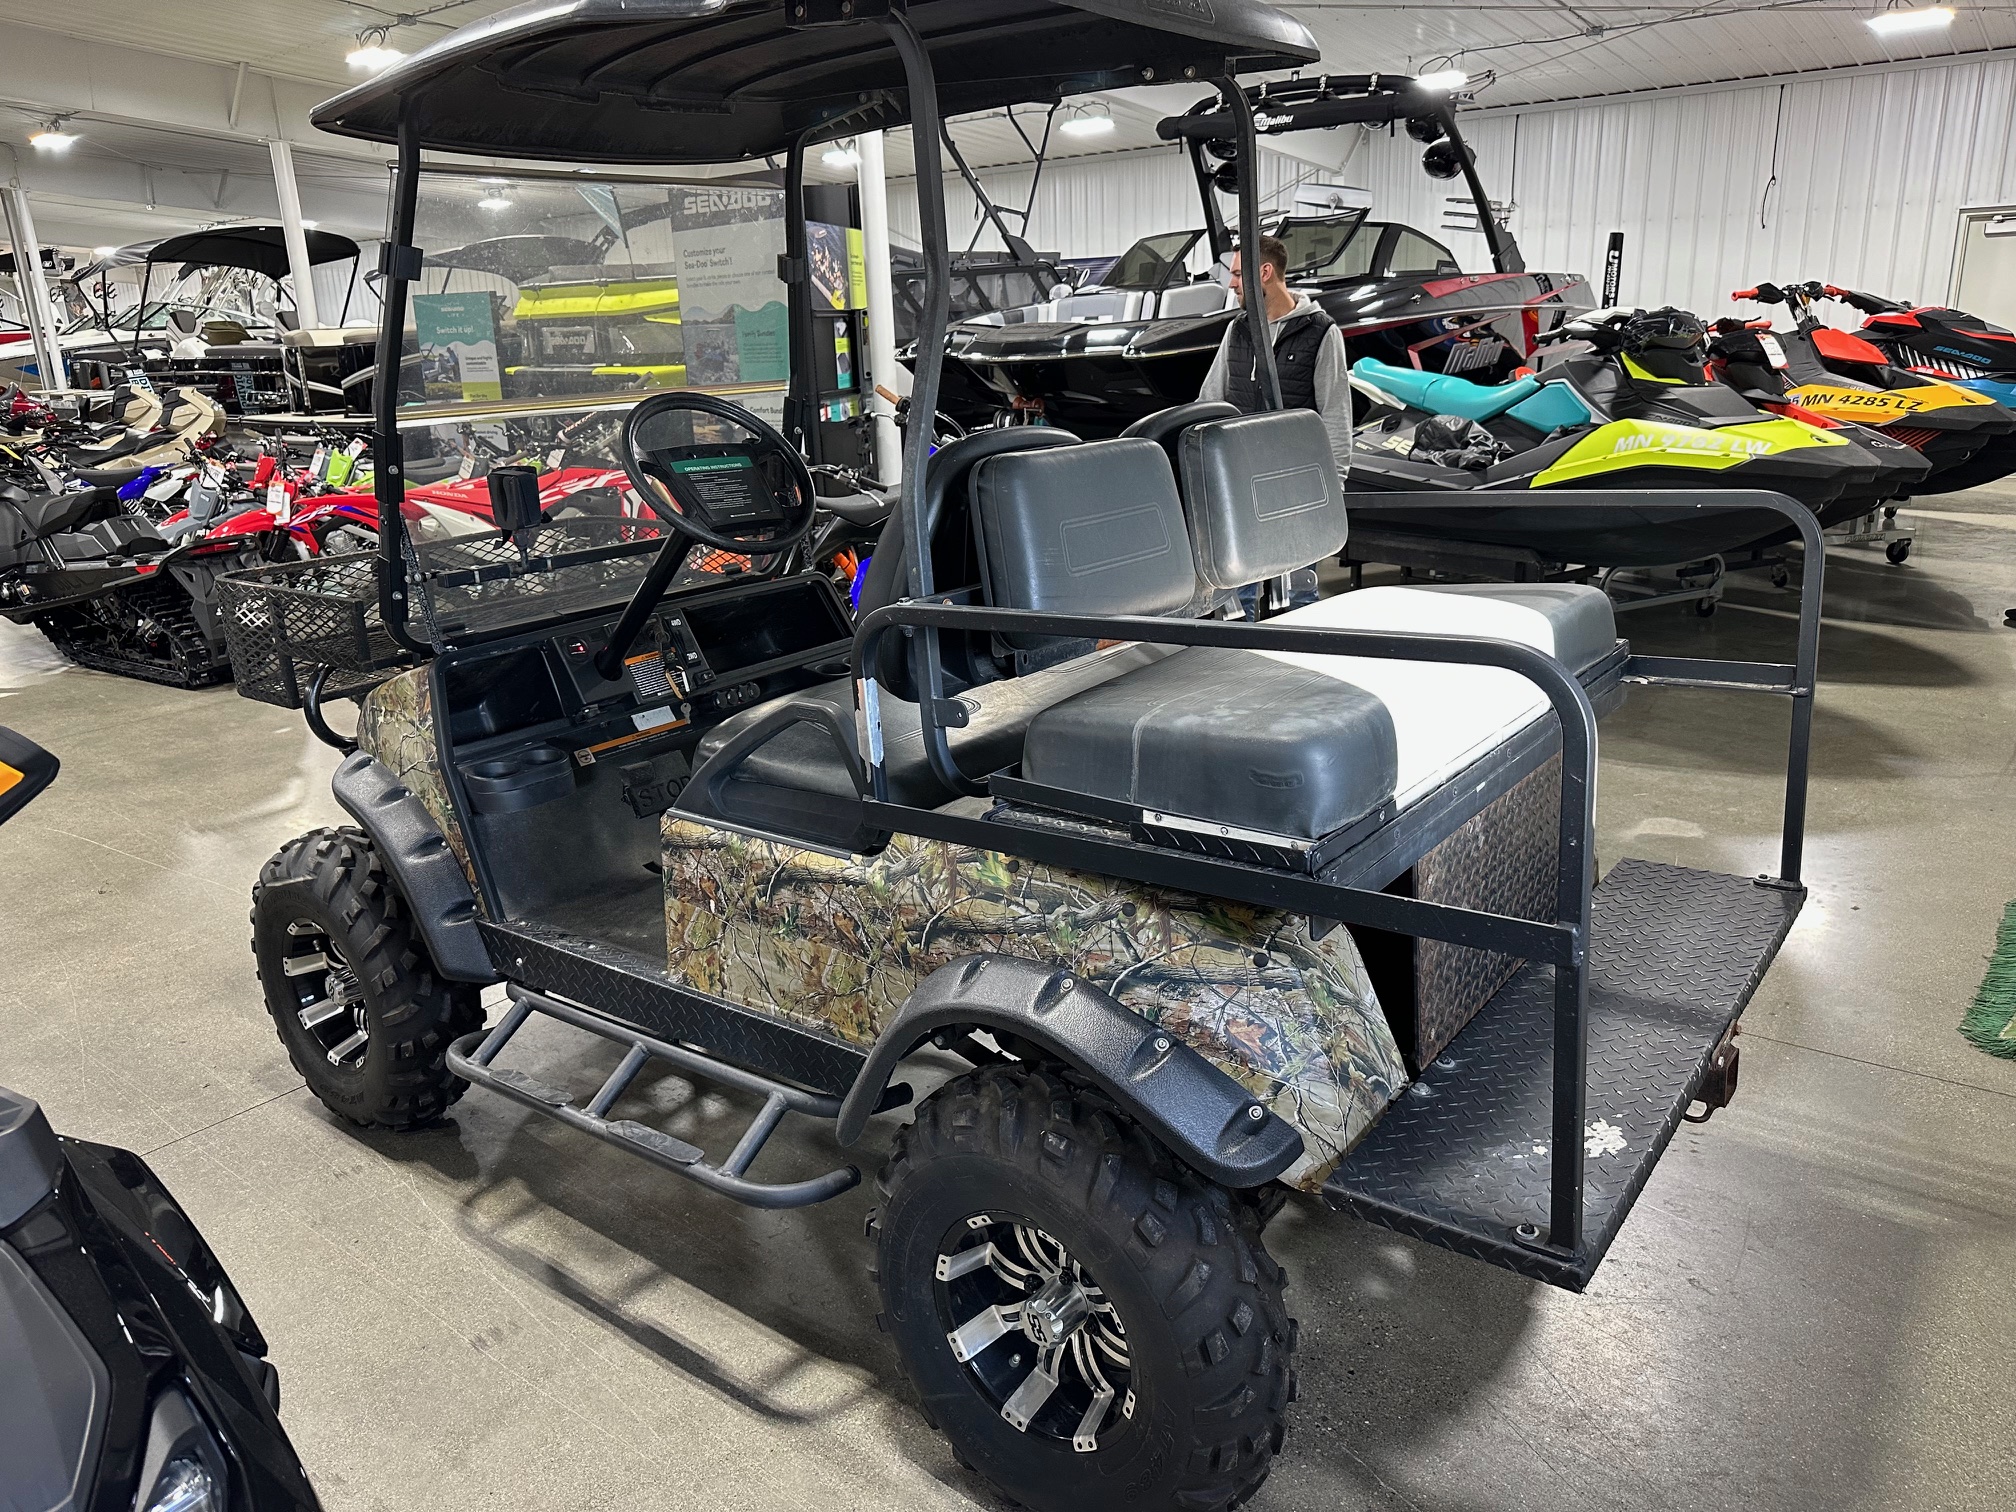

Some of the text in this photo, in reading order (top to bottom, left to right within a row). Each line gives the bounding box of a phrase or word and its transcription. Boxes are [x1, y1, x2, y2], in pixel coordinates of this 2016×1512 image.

[1801, 394, 1924, 411] MN 4285 LZ
[1614, 434, 1655, 453] MN
[1730, 440, 1773, 454] LW
[431, 490, 469, 499] HONDA
